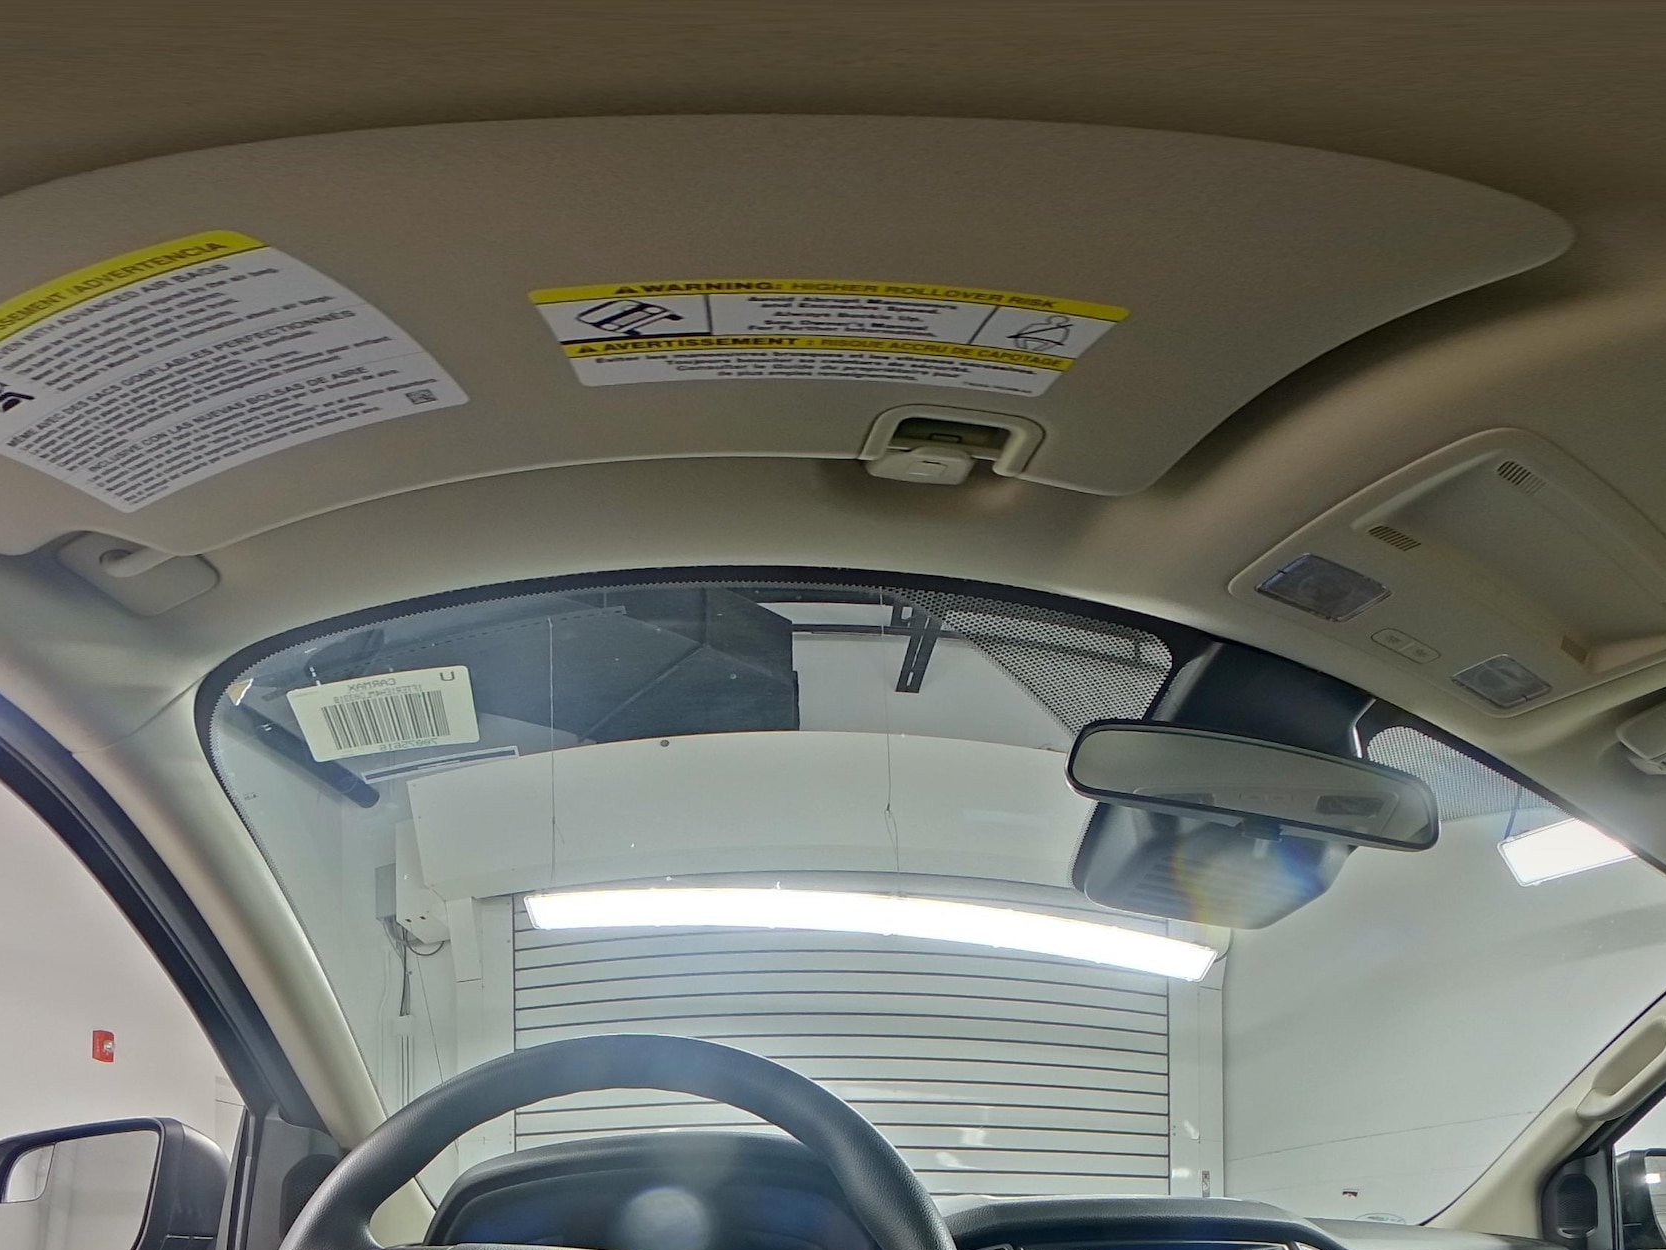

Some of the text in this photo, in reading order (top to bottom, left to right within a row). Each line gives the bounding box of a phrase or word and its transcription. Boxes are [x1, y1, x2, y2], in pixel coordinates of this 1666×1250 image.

[20, 323, 63, 342] WITH
[53, 290, 144, 325] ADVANCED
[134, 279, 176, 293] AIR
[168, 263, 232, 282] BAGS
[641, 281, 1059, 309] WARNING: HIGHER ROLLOVER RISK
[31, 411, 69, 431] AVEC
[60, 399, 92, 414] DES
[83, 383, 124, 402] SACS
[116, 347, 217, 387] GONFLABLES
[603, 337, 800, 351] AVERTISSEMENT
[820, 339, 884, 349] RISQUE
[889, 341, 948, 353] ACCRU
[951, 346, 973, 355] DE
[976, 349, 1063, 368] CAPOTAGE
[87, 366, 370, 473] INCLUSIVE CON LAS NUEVAS BOLSAS DE AIRE
